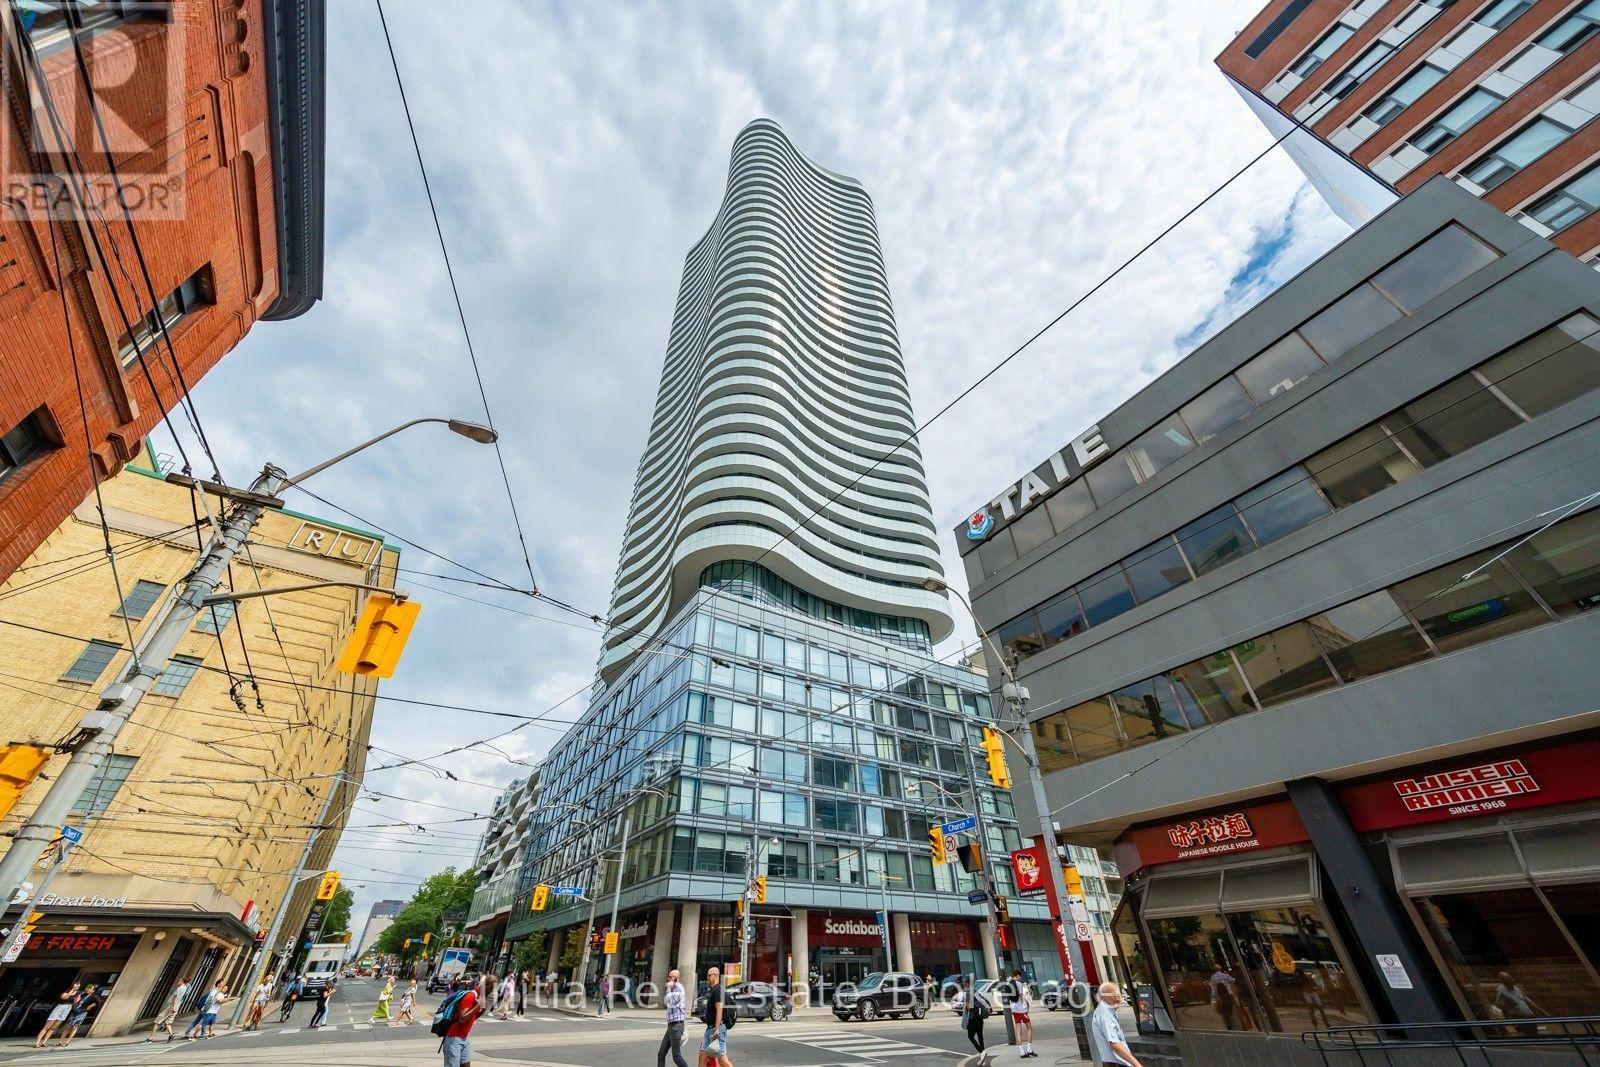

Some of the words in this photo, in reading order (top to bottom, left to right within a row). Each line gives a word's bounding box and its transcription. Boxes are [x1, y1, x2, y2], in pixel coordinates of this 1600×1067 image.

[991, 424, 1110, 520] TAIE
[1393, 758, 1529, 797] AJISEN
[1402, 774, 1540, 811] RAMEN
[1449, 803, 1480, 815] SINCE
[1480, 799, 1506, 811] 1968
[947, 822, 966, 832] Church
[1177, 847, 1209, 859] JAPANESE
[1208, 843, 1236, 855] NOODLE
[1235, 839, 1260, 849] HOUSE
[41, 893, 85, 907] Great
[89, 896, 128, 908] food
[825, 919, 881, 935] Scotiaban
[47, 936, 115, 950] FRESH
